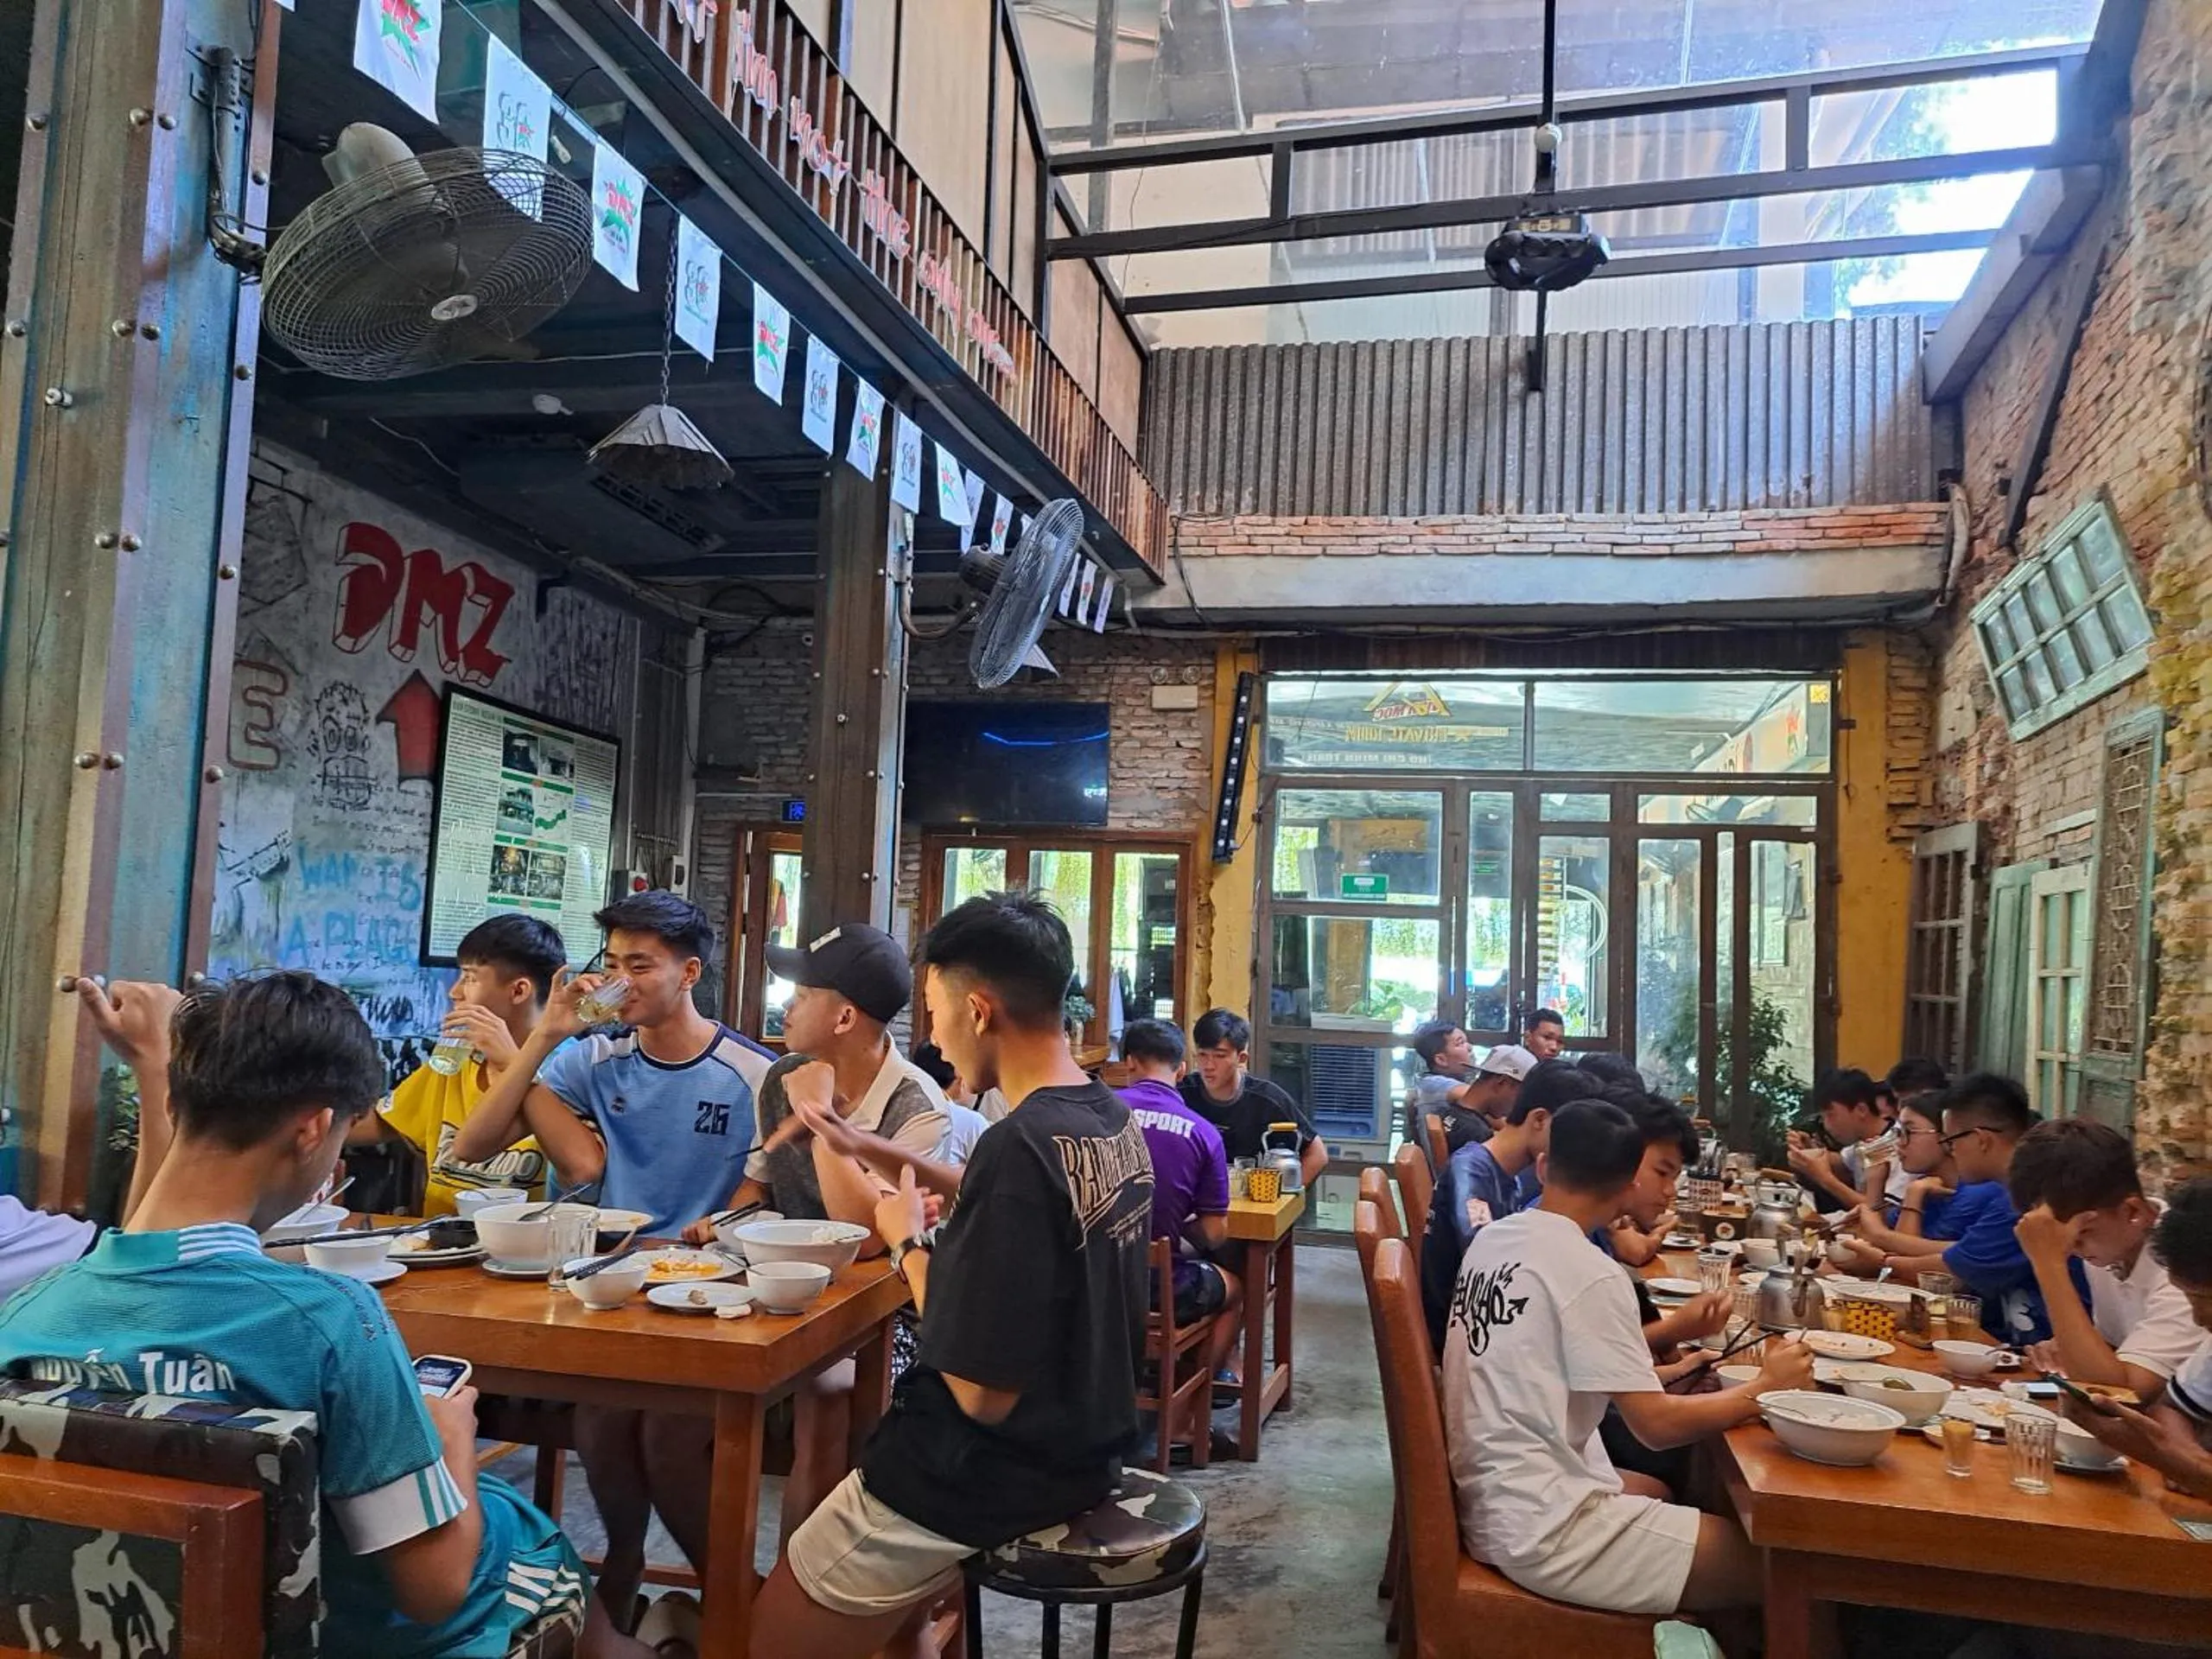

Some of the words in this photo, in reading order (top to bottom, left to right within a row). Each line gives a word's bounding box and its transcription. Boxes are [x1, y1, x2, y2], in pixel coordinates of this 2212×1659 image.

[790, 95, 851, 195] not
[858, 168, 911, 259] the
[918, 250, 963, 339] only
[332, 522, 516, 688] DMZ
